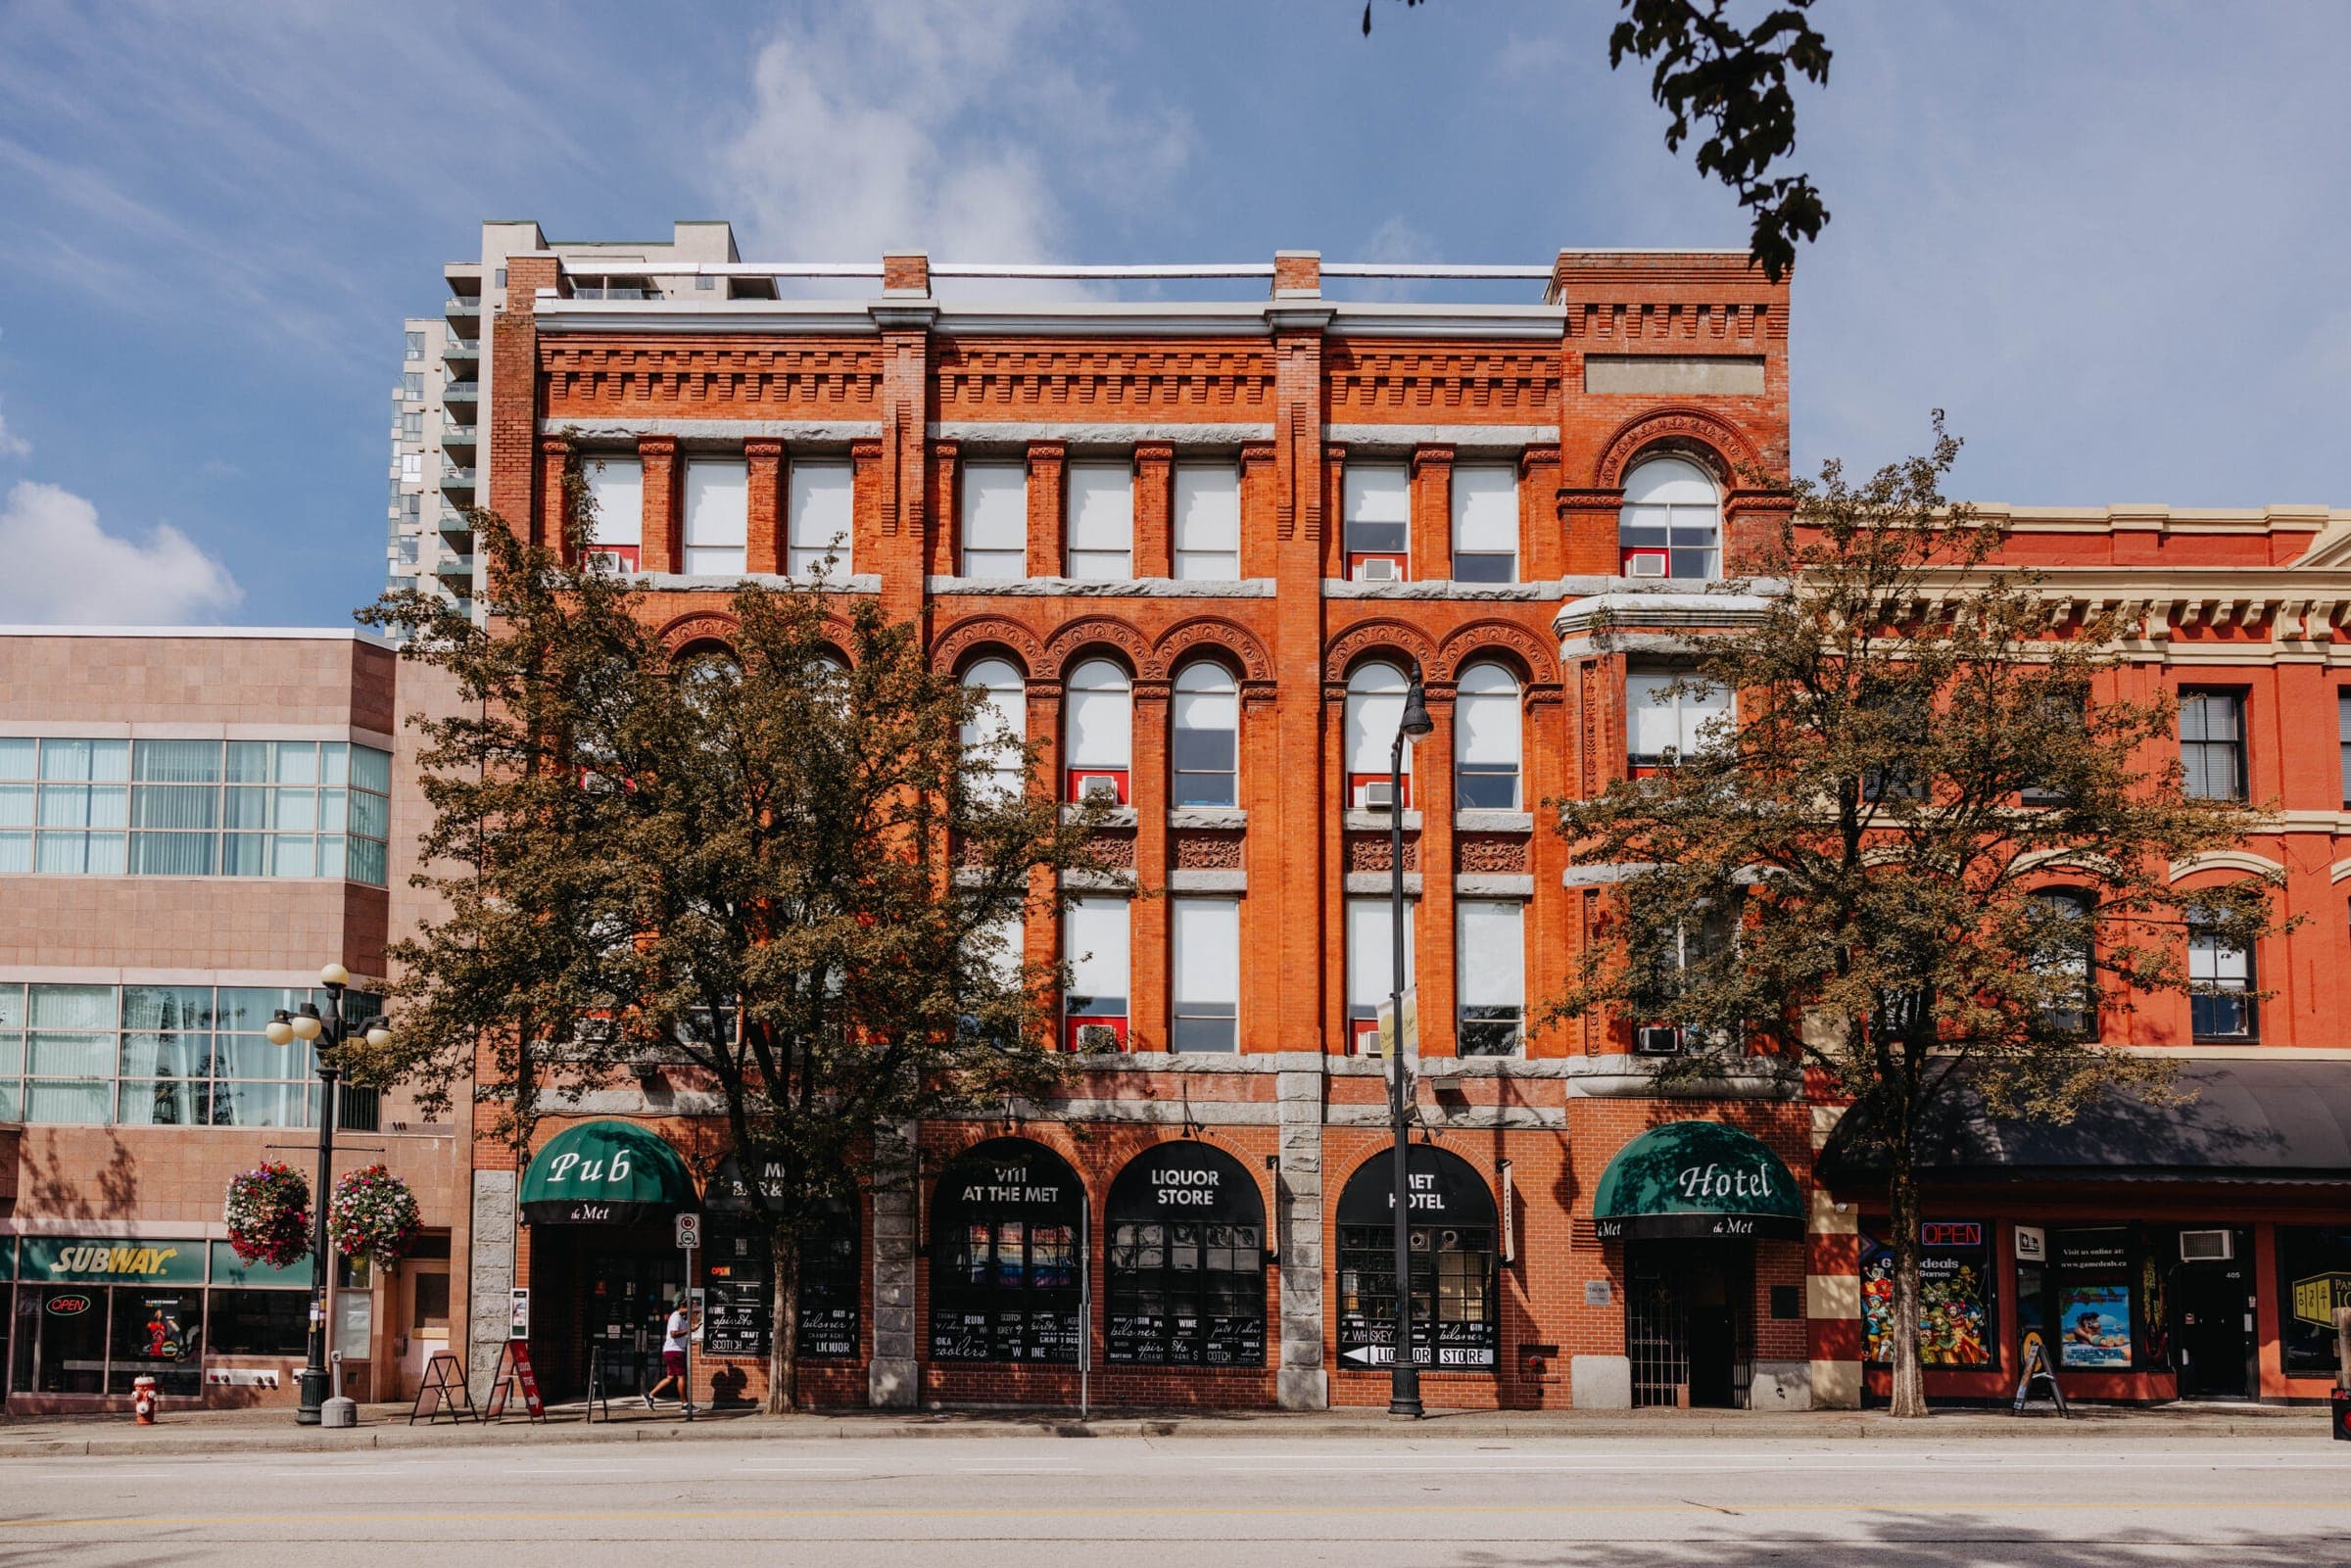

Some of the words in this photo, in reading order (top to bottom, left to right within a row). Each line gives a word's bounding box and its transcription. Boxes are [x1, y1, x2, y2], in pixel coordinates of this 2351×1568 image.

[546, 1149, 631, 1183] Pub
[1151, 1169, 1220, 1186] LIQUOR
[1679, 1163, 1773, 1198] Hotel
[961, 1186, 984, 1202] AT
[986, 1186, 1020, 1203] THE
[1024, 1186, 1060, 1203] MET
[1157, 1189, 1214, 1206] STORE
[582, 1204, 609, 1220] Met
[1726, 1217, 1753, 1234] Met
[1923, 1224, 1980, 1244] OPEN
[50, 1247, 177, 1275] SUBWAY
[1882, 1258, 1959, 1269] Gdeals
[51, 1300, 85, 1310] OPEN
[964, 1315, 984, 1324] RUM
[1178, 1319, 1197, 1328] WINE
[1352, 1331, 1393, 1342] WHISKEY
[1443, 1350, 1483, 1362] STORE
